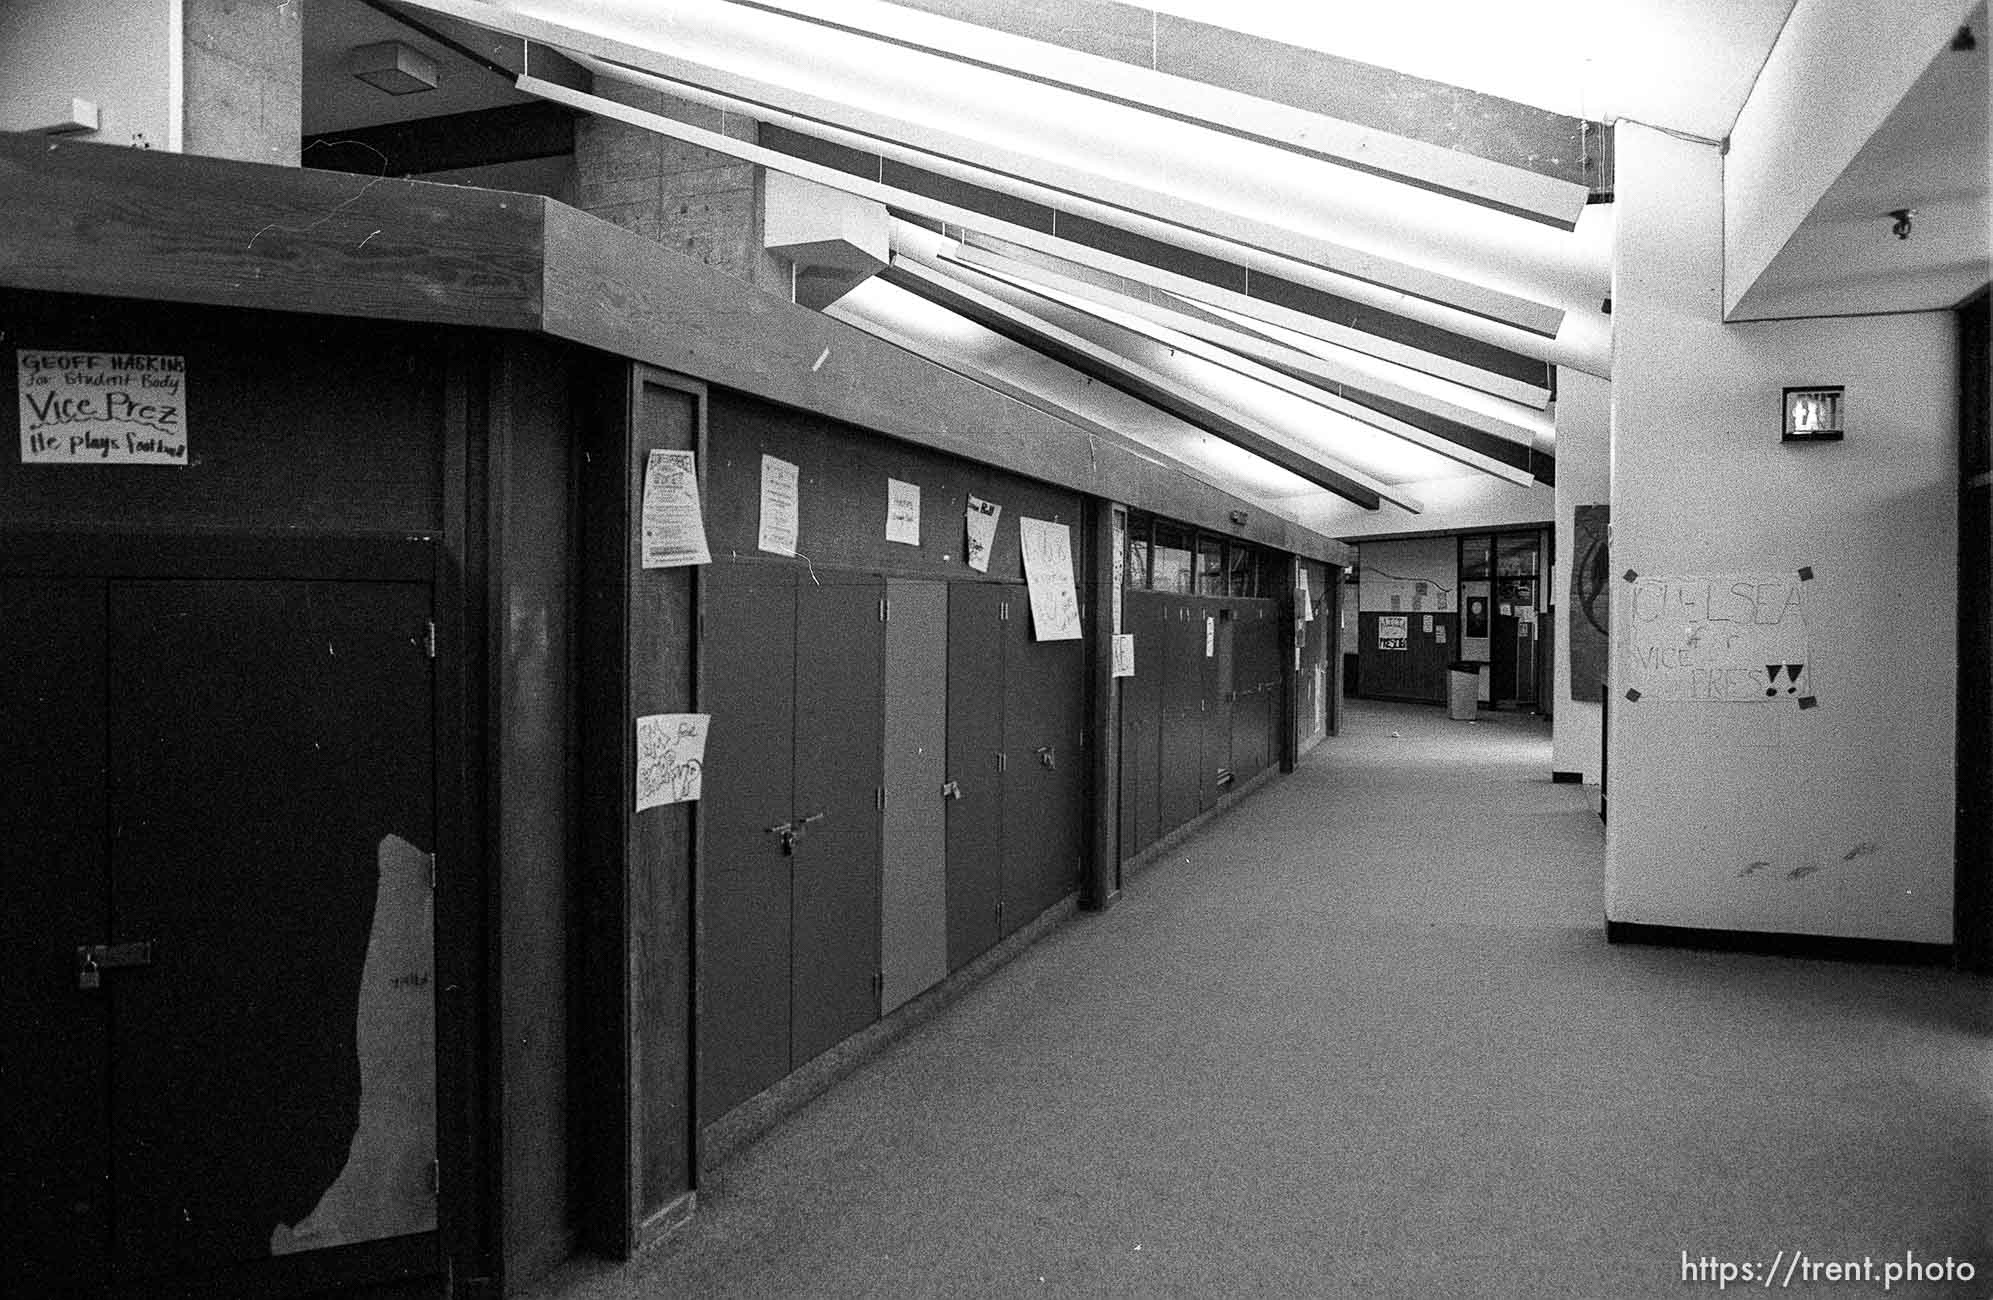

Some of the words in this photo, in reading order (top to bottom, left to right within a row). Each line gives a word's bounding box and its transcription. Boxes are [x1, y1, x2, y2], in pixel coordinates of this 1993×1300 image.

[22, 355, 102, 373] GEOFF
[141, 375, 179, 395] Body
[26, 390, 97, 421] Vice
[106, 391, 178, 424] Prez
[30, 432, 62, 453] He
[70, 431, 120, 457] plays
[1634, 646, 1694, 670] VICE
